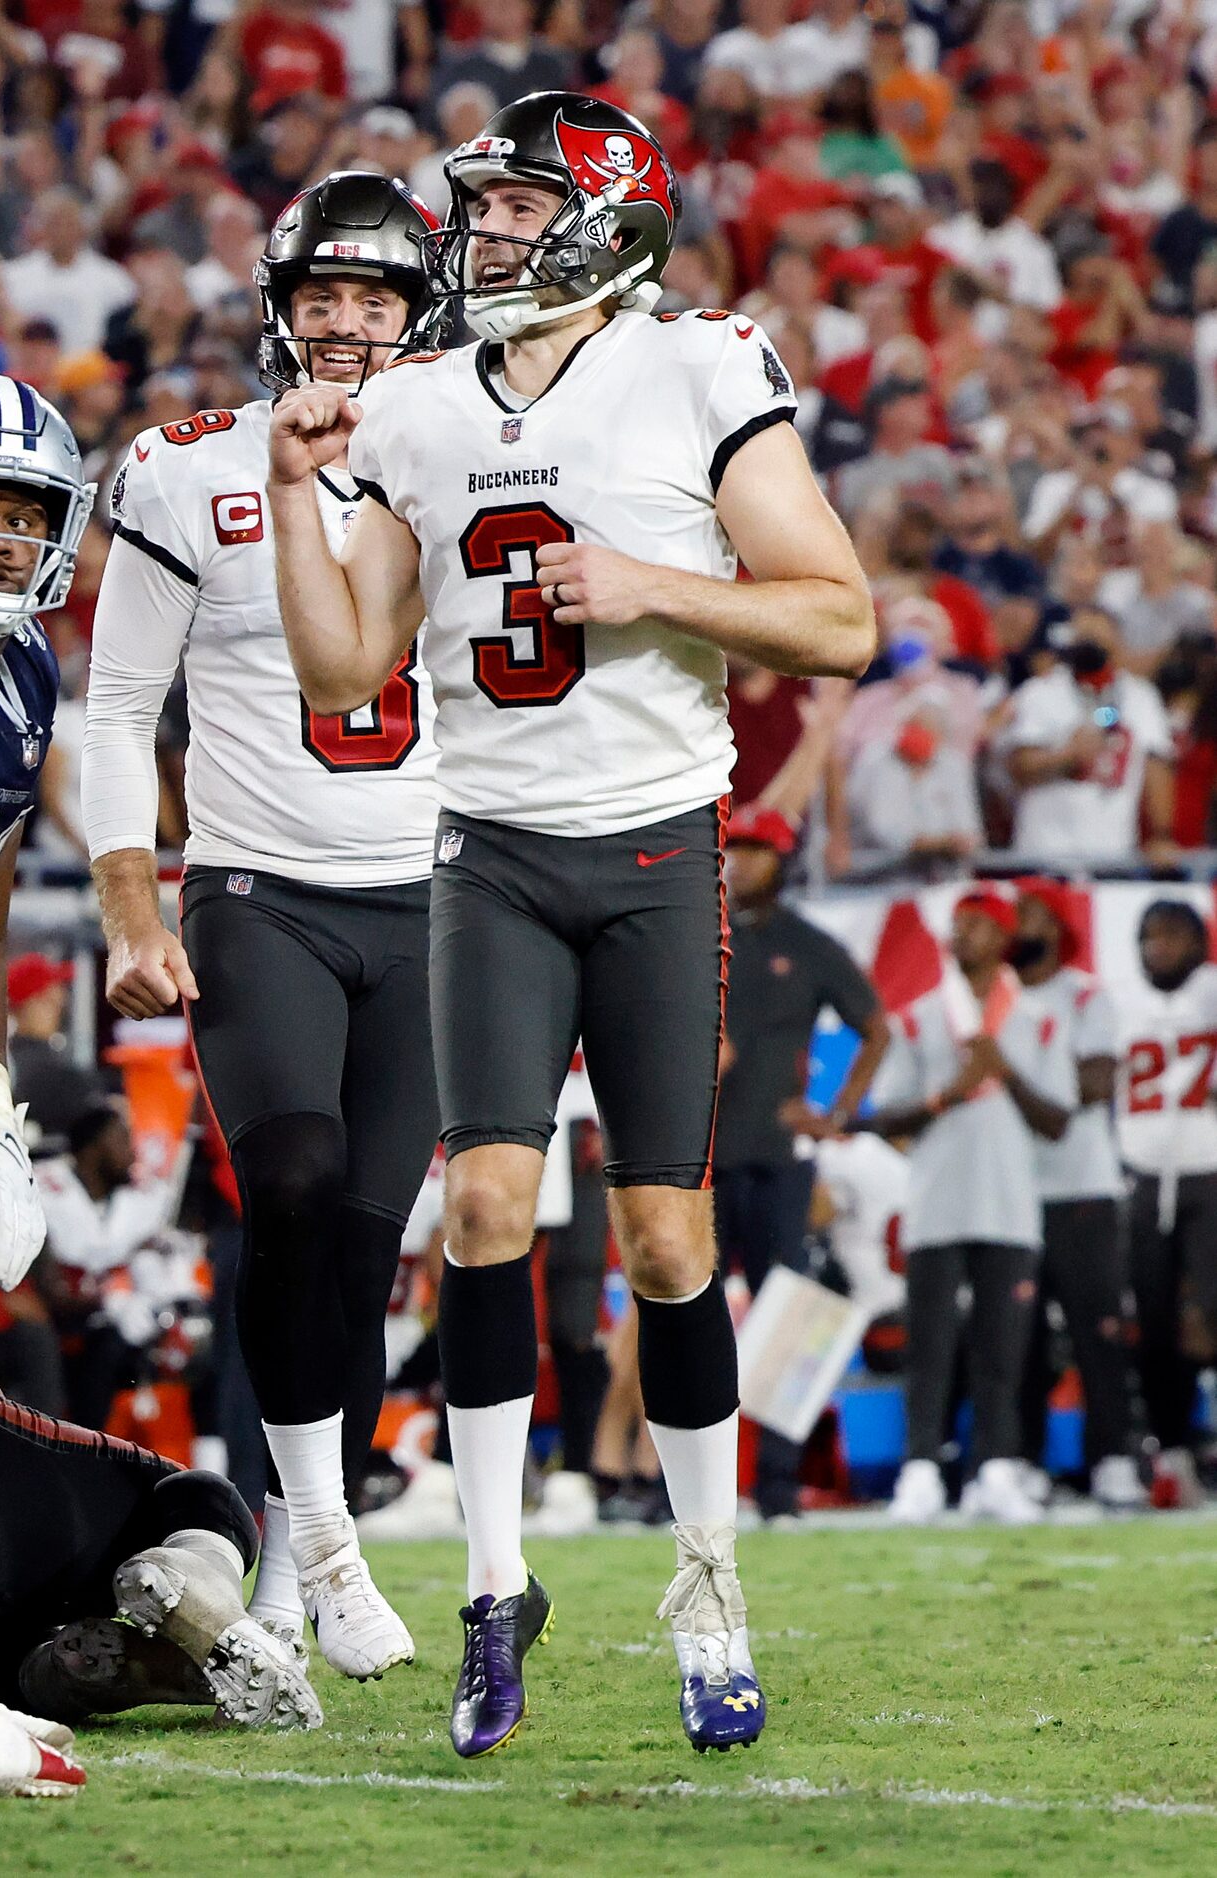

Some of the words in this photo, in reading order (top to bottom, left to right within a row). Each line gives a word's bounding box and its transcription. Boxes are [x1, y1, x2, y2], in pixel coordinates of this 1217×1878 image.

[160, 410, 237, 446] 8
[468, 466, 559, 494] BUCCANEERS
[216, 494, 261, 533] C
[458, 501, 586, 709] 3
[1128, 1032, 1217, 1113] 27
